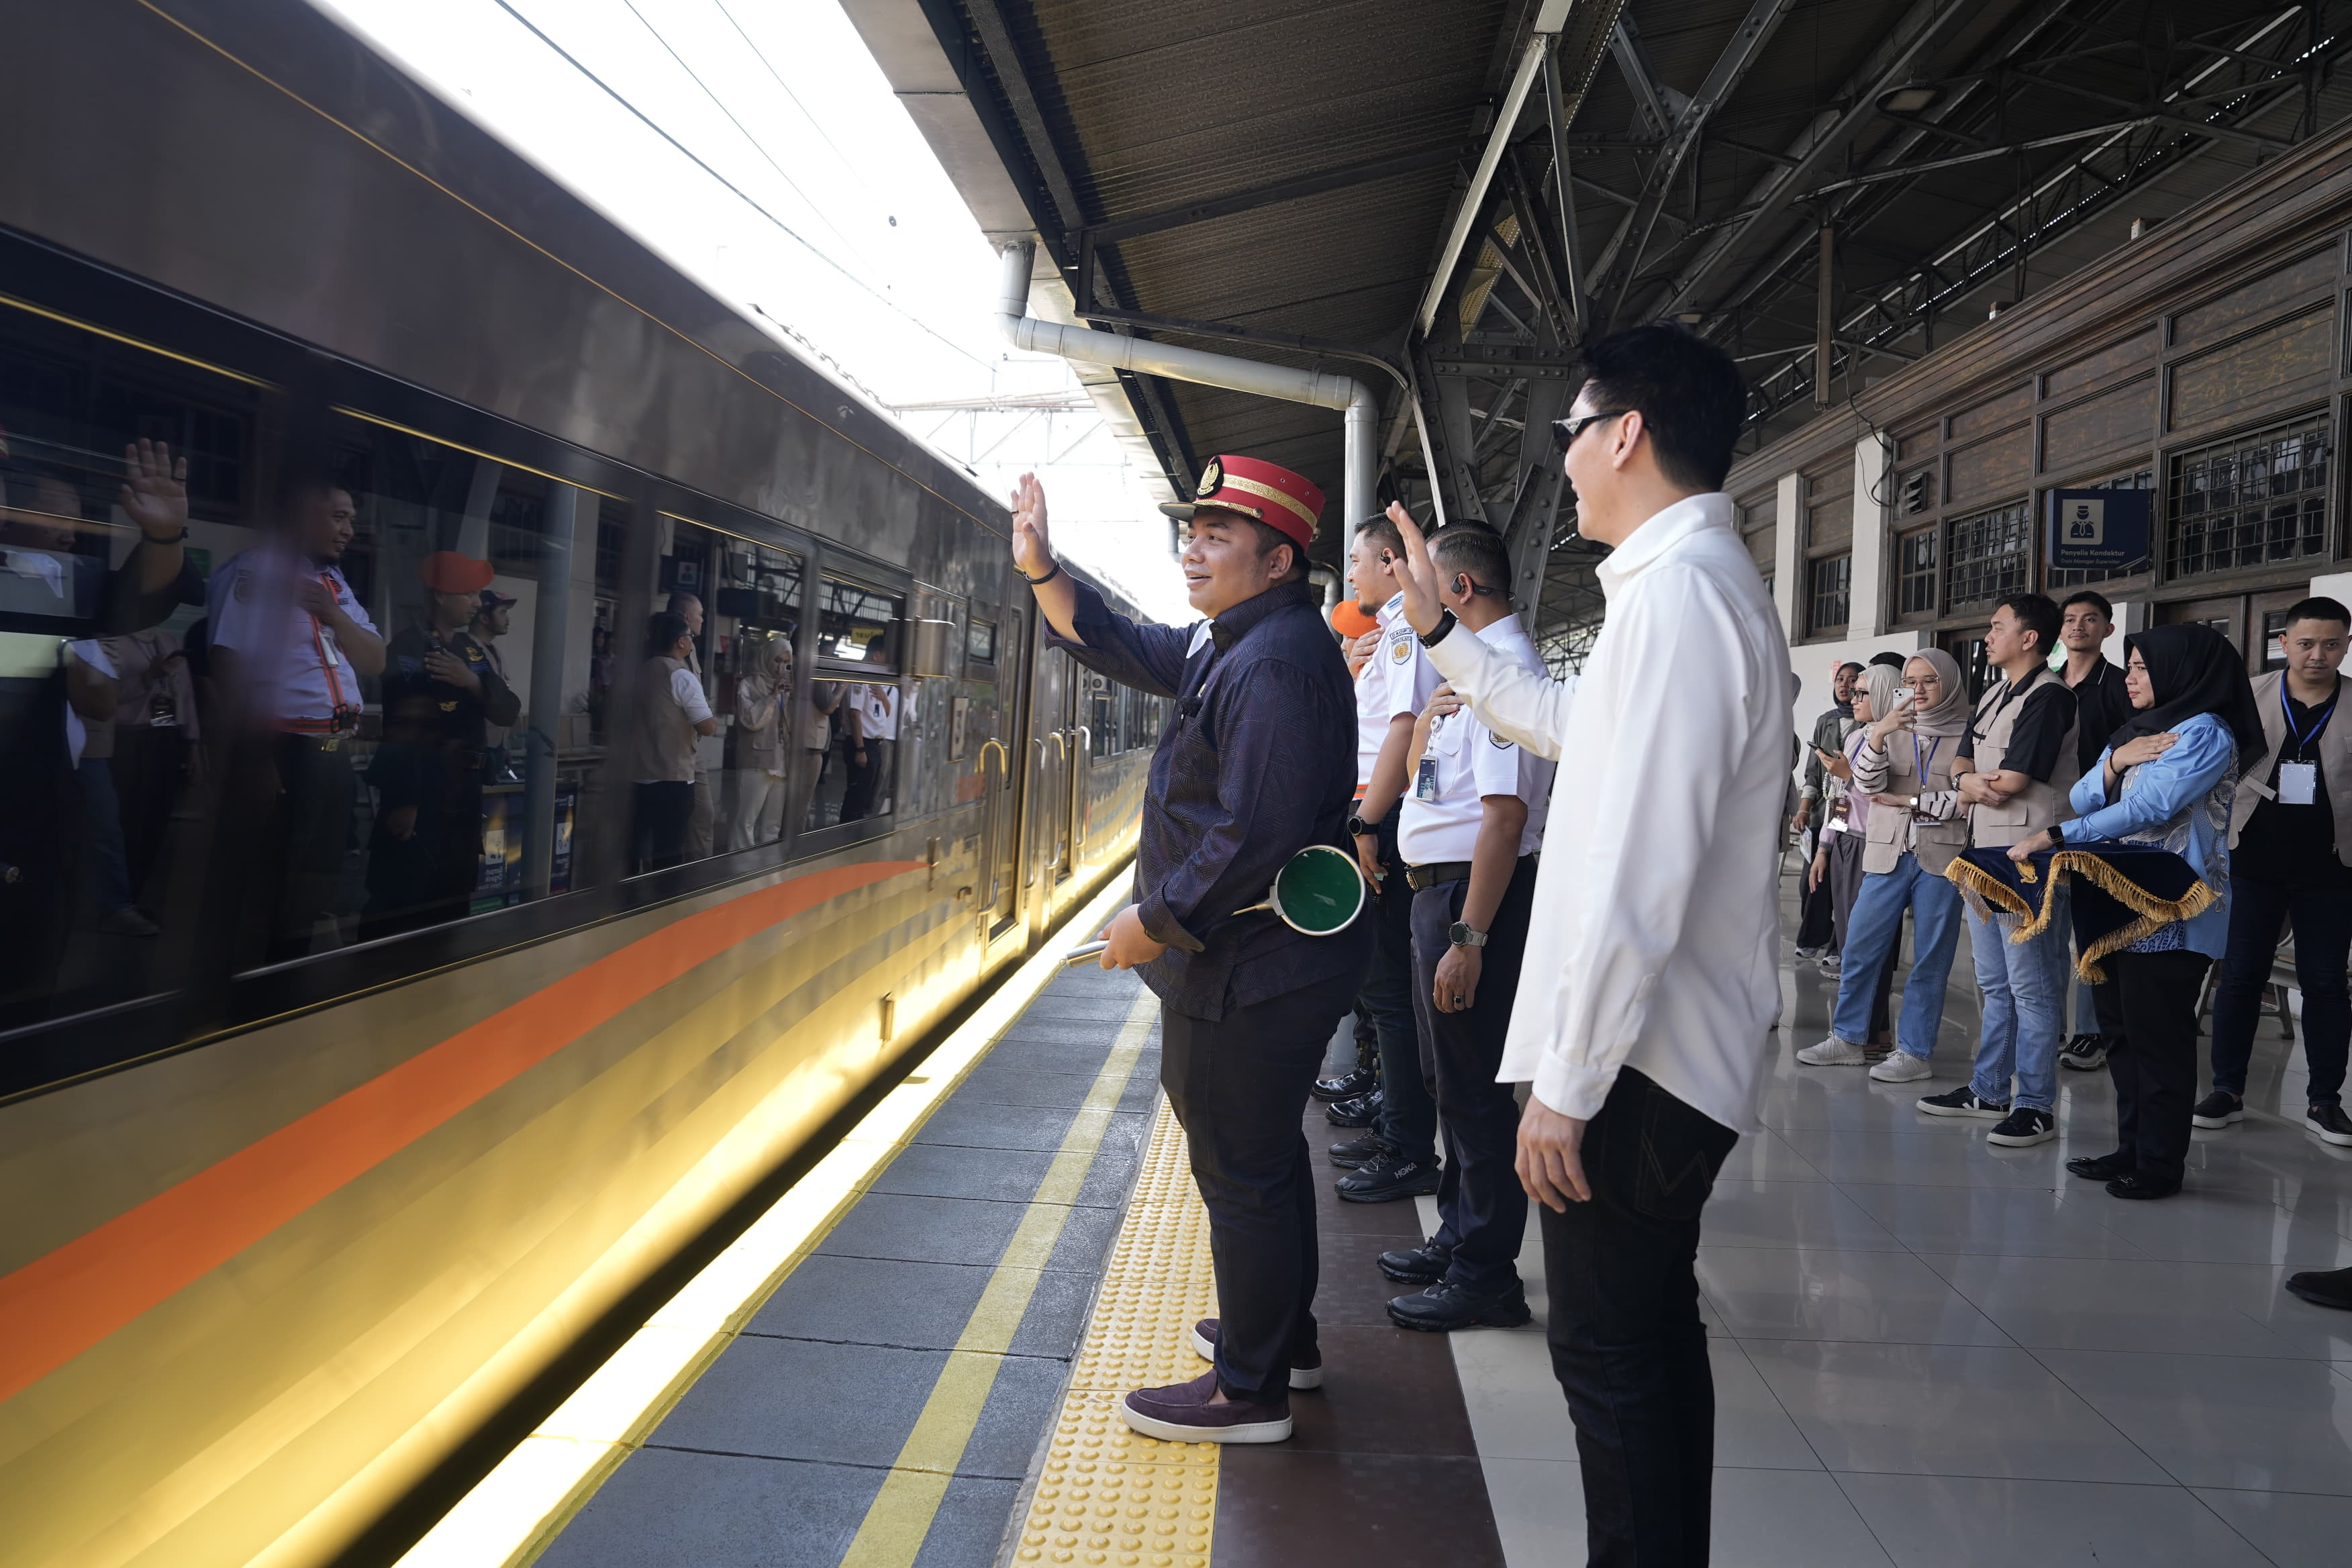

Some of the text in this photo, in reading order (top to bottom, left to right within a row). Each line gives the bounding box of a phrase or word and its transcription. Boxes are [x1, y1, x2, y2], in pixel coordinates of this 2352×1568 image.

[2061, 549, 2088, 557] Penyelia
[1391, 629, 1407, 638] DAOP
[1393, 1161, 1418, 1179] HOKA
